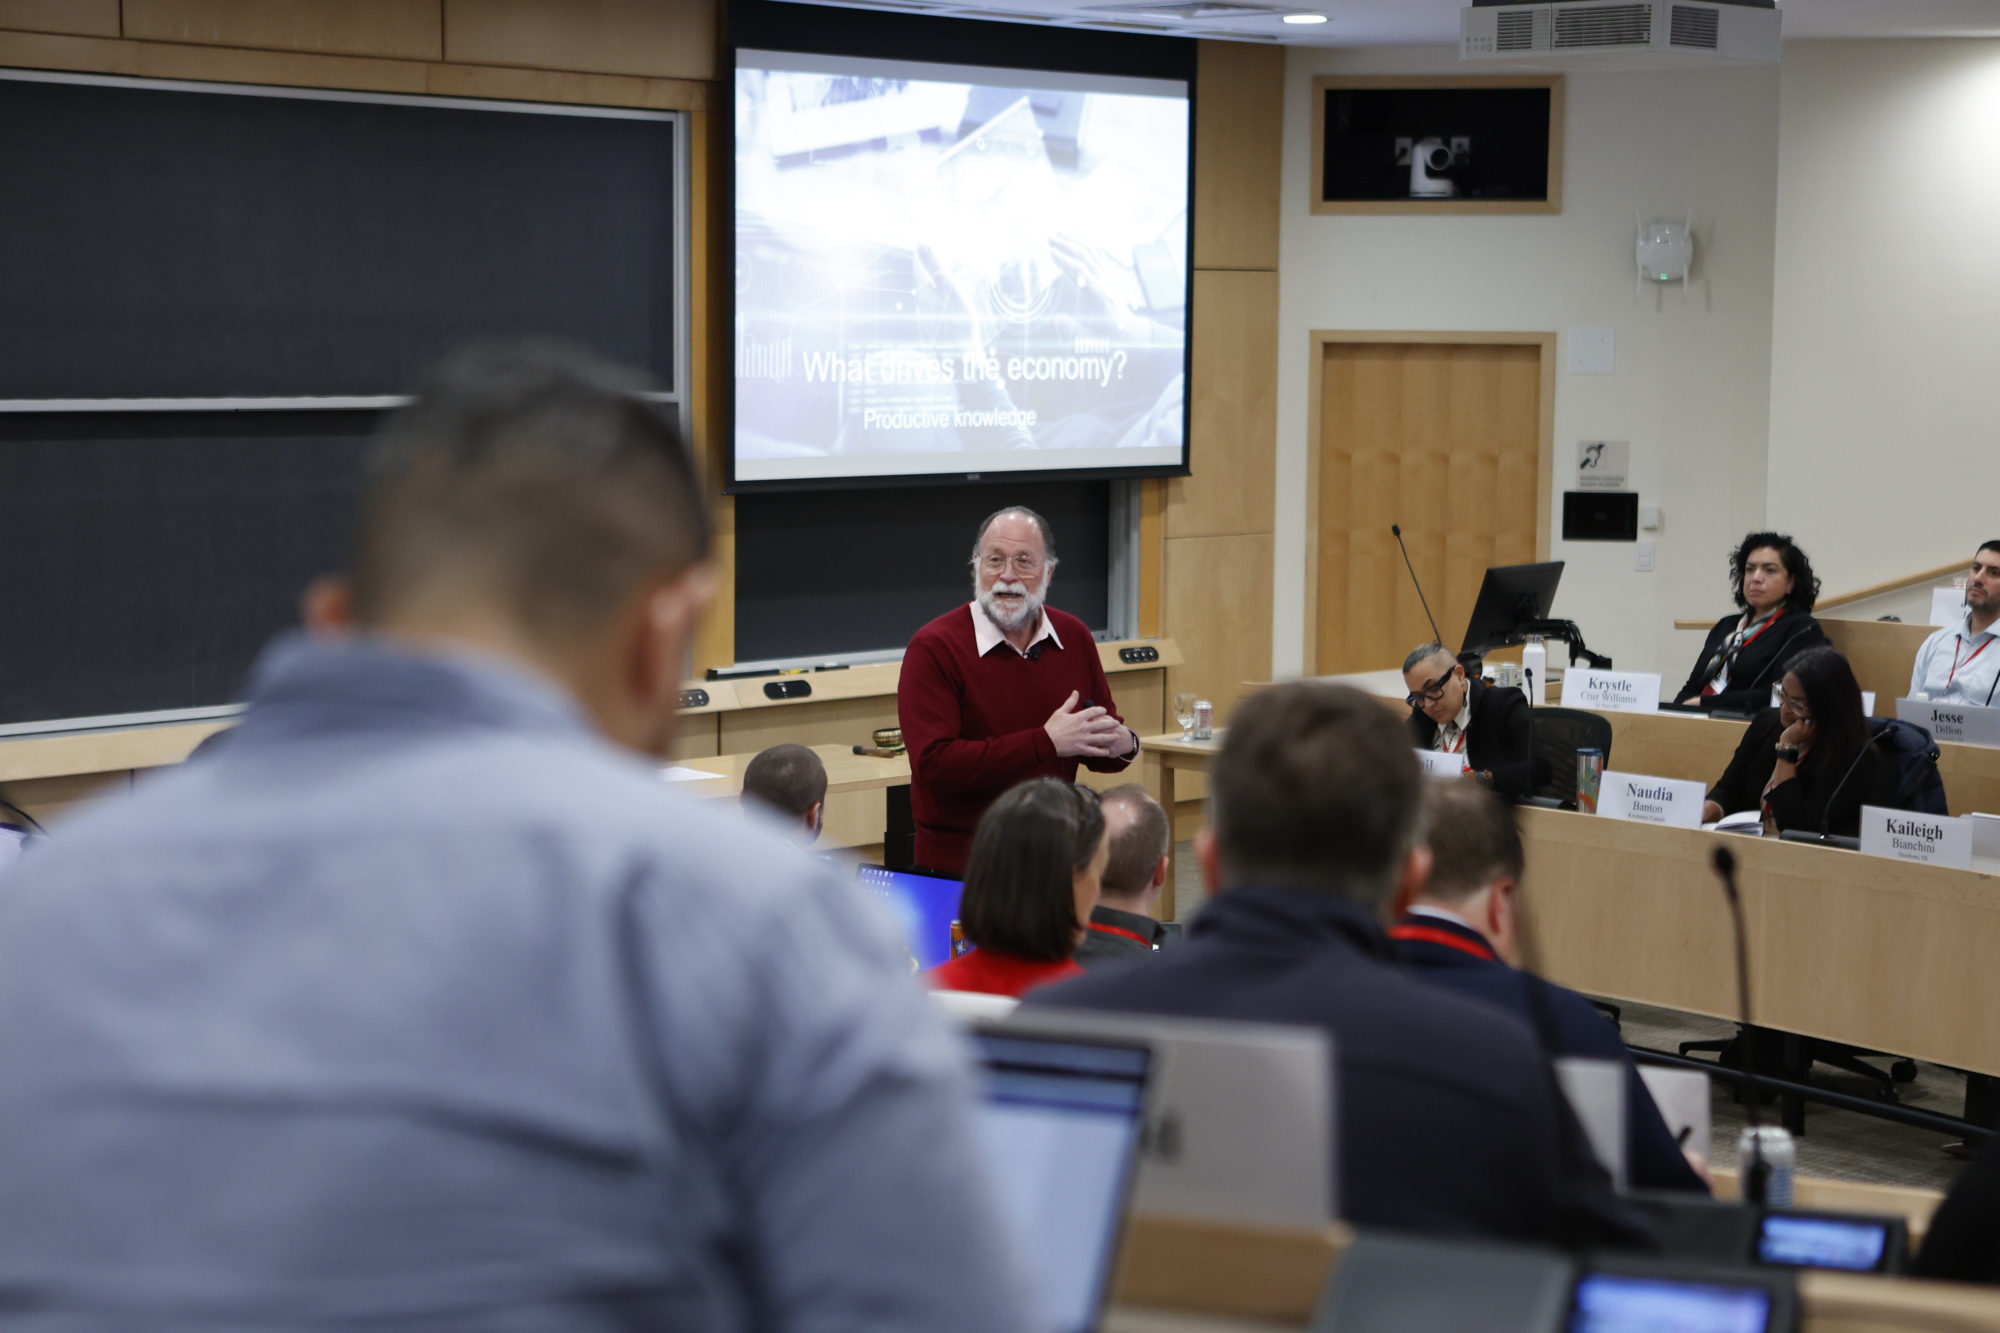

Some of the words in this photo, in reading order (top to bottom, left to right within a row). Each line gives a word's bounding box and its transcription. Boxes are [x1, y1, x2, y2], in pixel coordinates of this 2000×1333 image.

[803, 351, 872, 383] What
[880, 351, 955, 382] drives
[963, 351, 1000, 381] the
[1007, 350, 1127, 387] economy?
[864, 409, 949, 430] Productive
[954, 407, 1037, 430] knowledge
[1588, 677, 1632, 693] Krystle
[1581, 691, 1599, 701] Cruz
[1602, 692, 1637, 703] Williams
[1931, 709, 1964, 724] Jesse
[1935, 725, 1962, 736] Dillon
[1627, 783, 1673, 802] Naudia
[1633, 800, 1663, 814] Banton
[1886, 819, 1943, 843] Kaileigh
[1892, 838, 1935, 854] Bianchini
